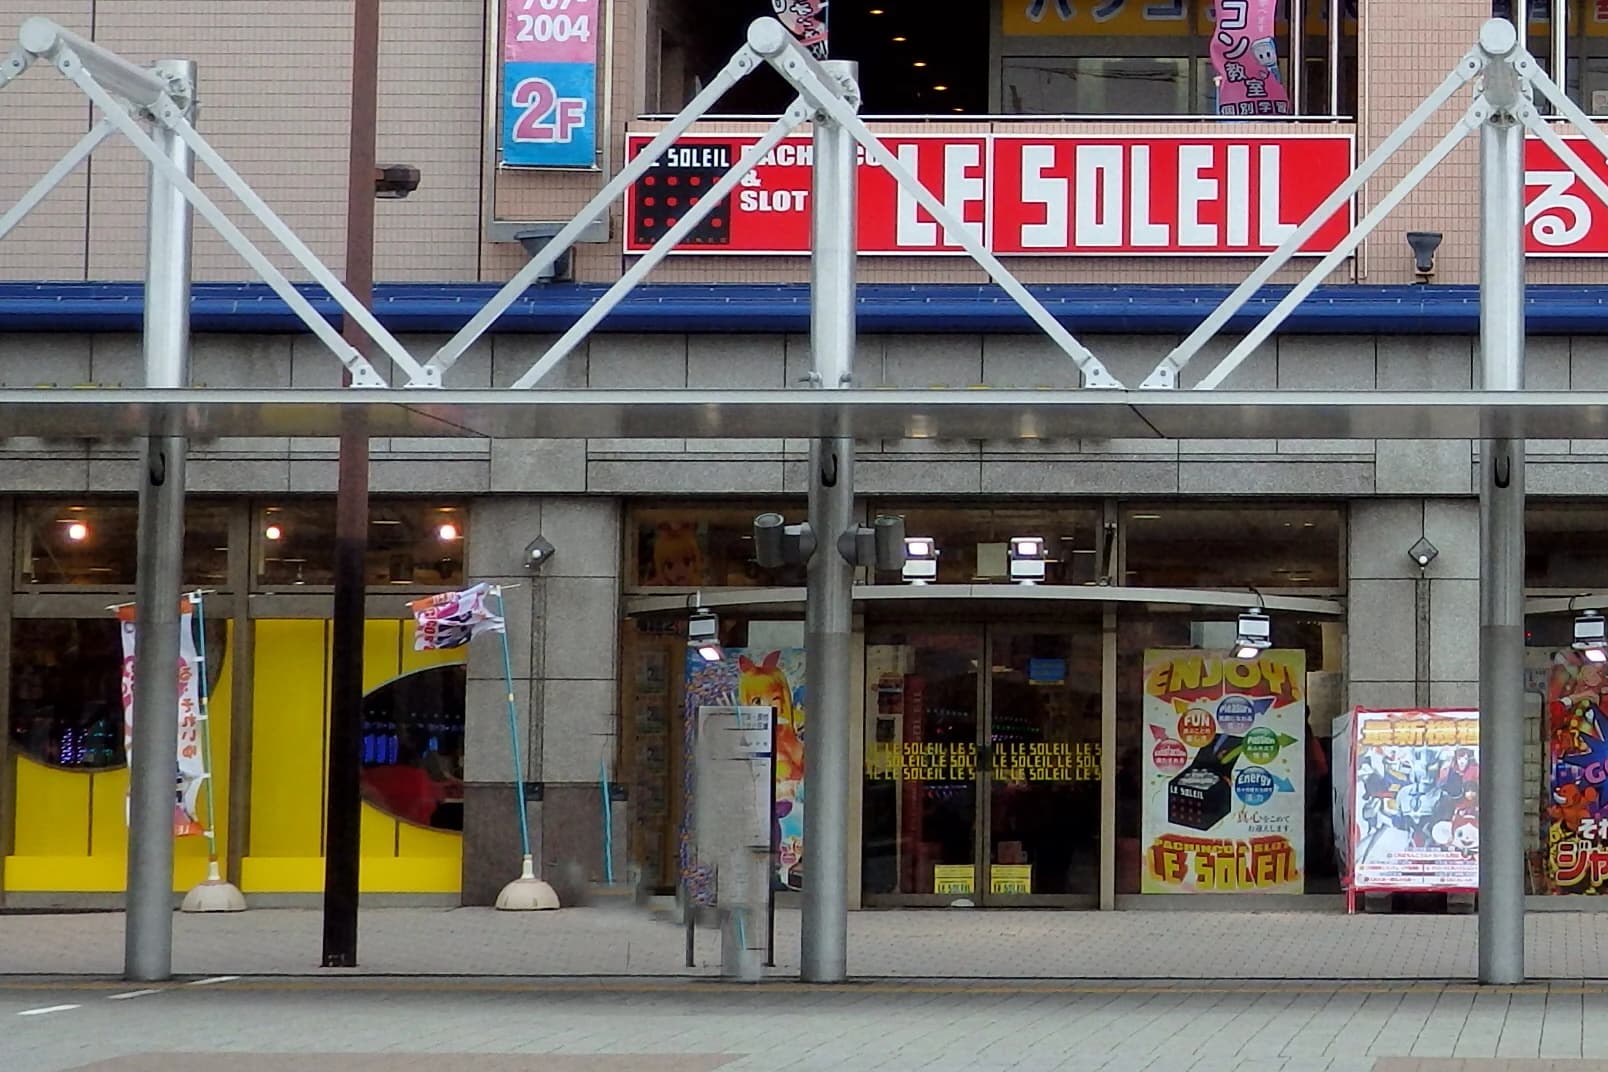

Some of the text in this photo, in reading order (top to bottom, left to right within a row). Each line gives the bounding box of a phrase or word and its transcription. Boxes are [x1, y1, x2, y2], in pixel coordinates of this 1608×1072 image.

[517, 14, 590, 43] 2004
[512, 76, 586, 144] 2F
[667, 148, 730, 168] SOLEIL
[740, 190, 809, 211] SLOT
[897, 144, 1299, 247] LE SOLEIL
[1148, 655, 1302, 701] ENJOY!
[1184, 714, 1210, 727] FUN
[904, 742, 945, 754] SOLEIL
[950, 742, 965, 754] LE
[1011, 743, 1025, 755] LE
[1030, 743, 1072, 755] SOLEIL
[1076, 743, 1091, 755] LE
[932, 755, 947, 767] LE
[993, 756, 1007, 768] LE
[1011, 756, 1053, 768] SOLEIL
[1058, 756, 1072, 768] LE
[885, 768, 899, 780] LE
[904, 768, 946, 780] SOLEIL
[950, 768, 965, 780] LE
[1011, 768, 1025, 780] LE
[1030, 768, 1072, 780] SOLEIL
[1076, 768, 1090, 780] LE
[1238, 771, 1272, 786] Energy
[1147, 846, 1299, 891] LE SOLEIL
